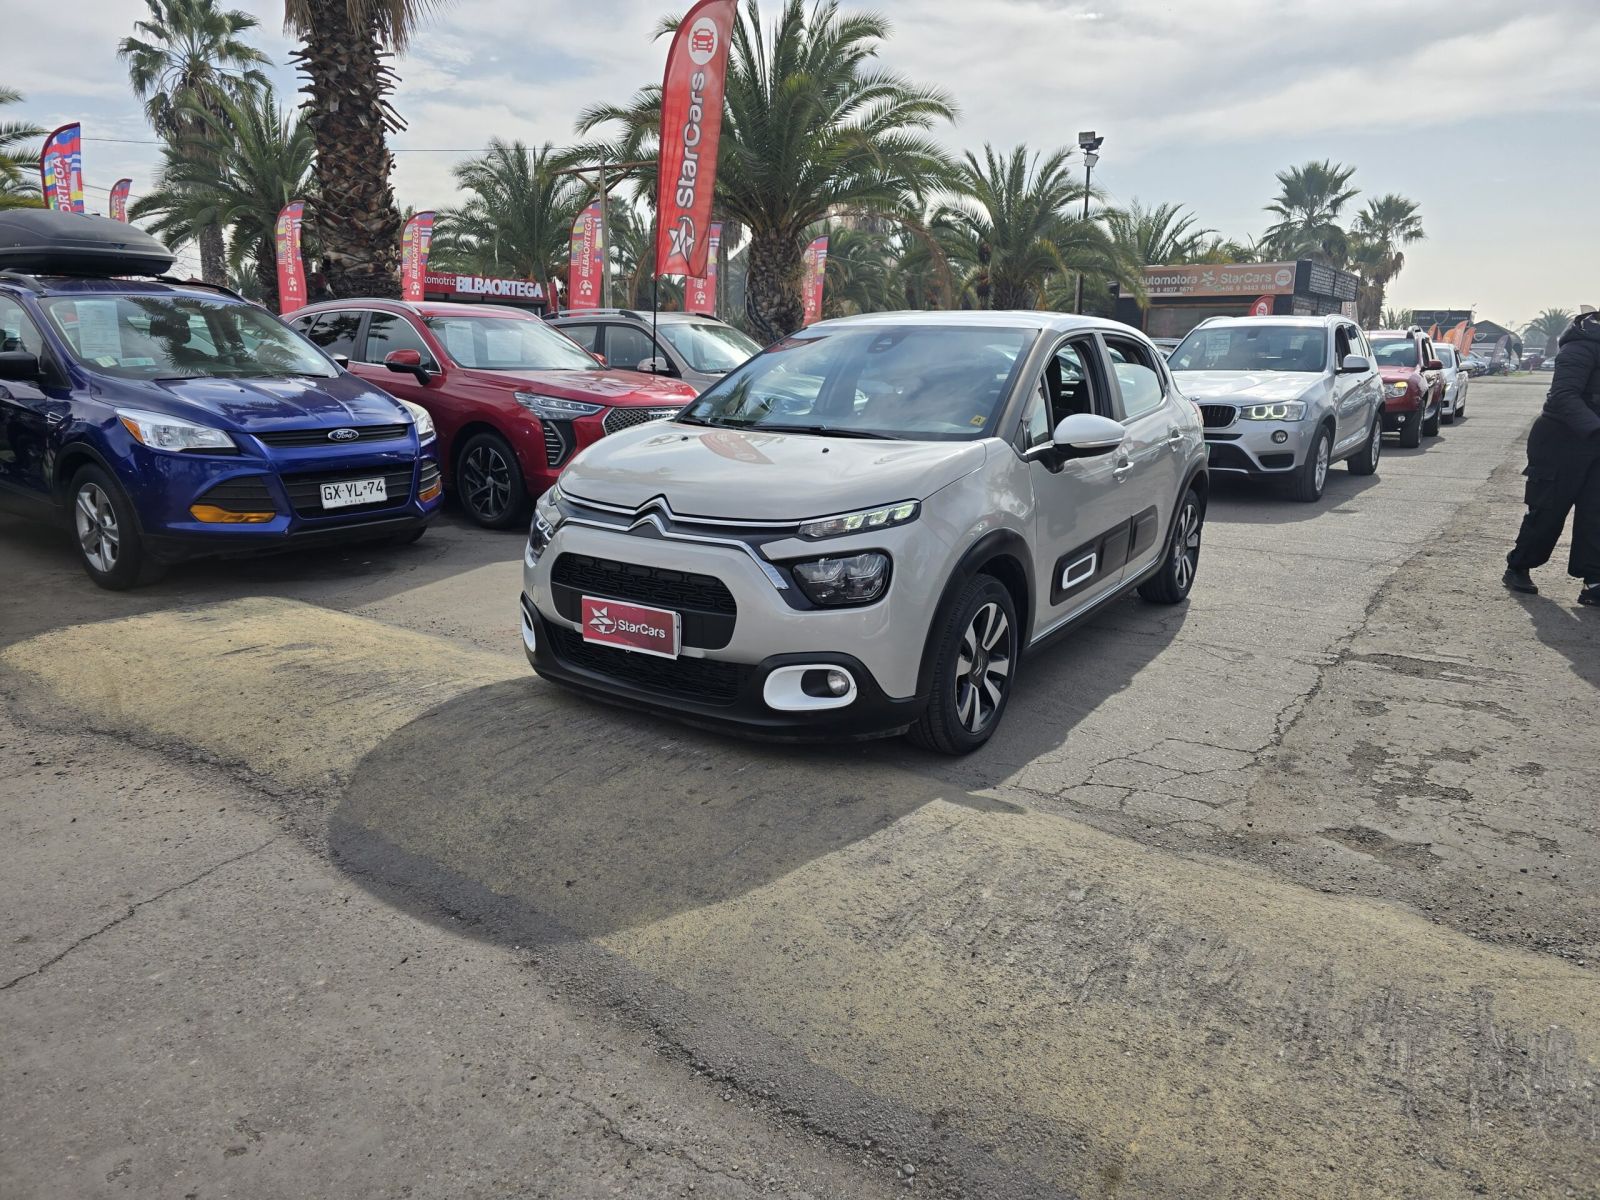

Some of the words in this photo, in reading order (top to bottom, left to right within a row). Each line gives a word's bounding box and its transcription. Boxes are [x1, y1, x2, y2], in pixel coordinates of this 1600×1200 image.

[676, 71, 706, 209] StarCars
[54, 155, 72, 212] ORTEGA
[411, 226, 420, 280] BILBAORTEGA
[581, 216, 593, 278] BILBAORTEGA
[424, 275, 456, 286] tomotriz
[456, 276, 543, 298] BILBAORTEGA
[1139, 273, 1198, 286] Automotora
[1220, 272, 1272, 285] StarCars
[336, 430, 353, 439] Ford
[618, 620, 666, 638] StarCars
